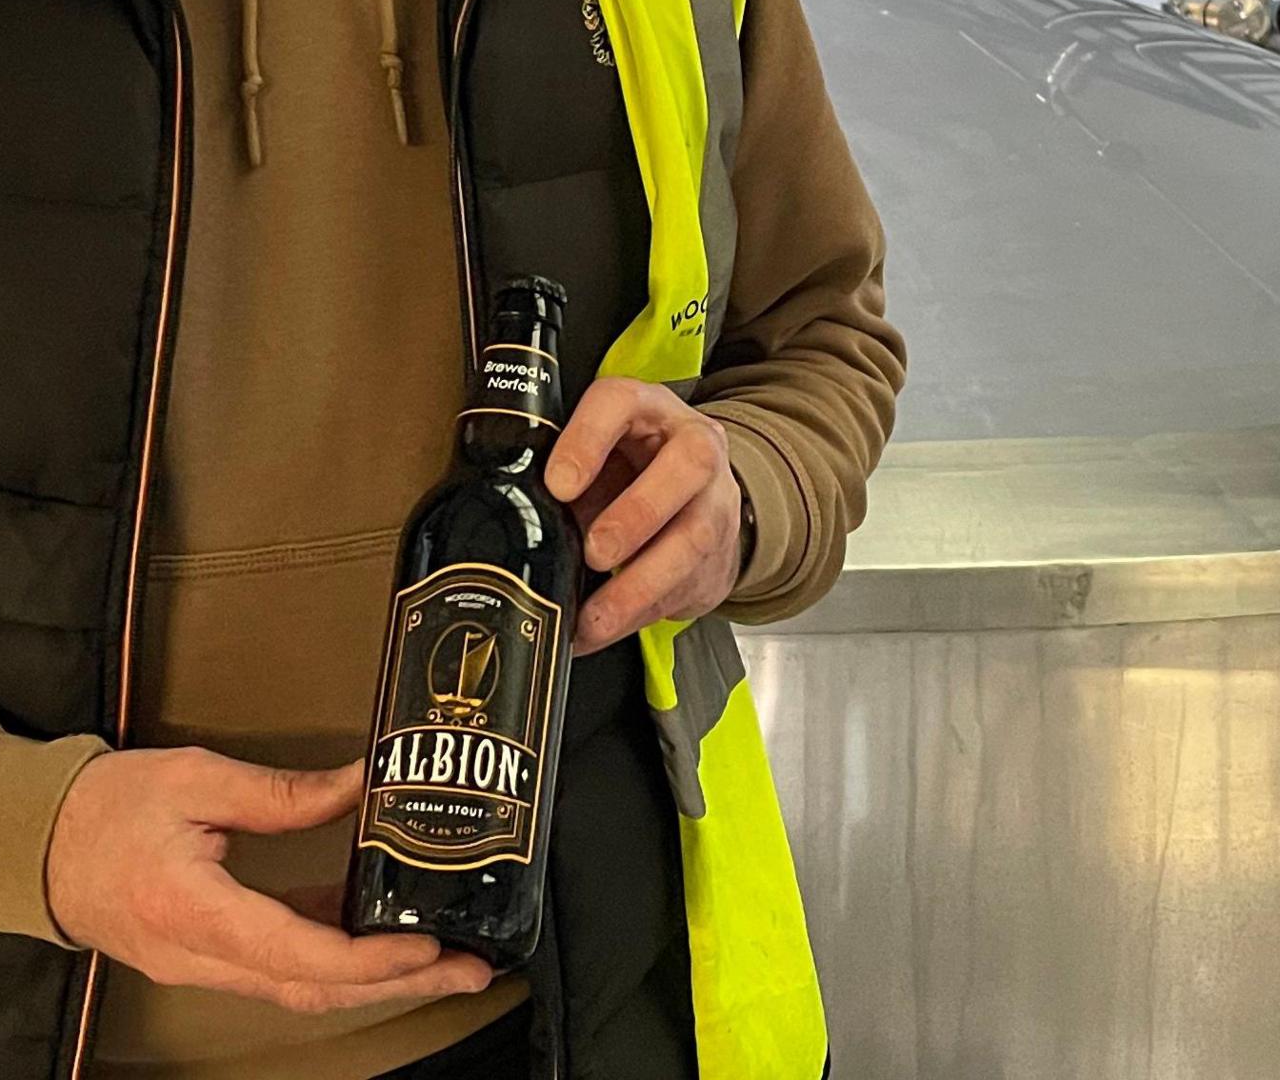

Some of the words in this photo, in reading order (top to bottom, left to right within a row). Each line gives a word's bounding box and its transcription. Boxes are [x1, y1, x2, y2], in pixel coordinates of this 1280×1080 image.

[484, 360, 538, 378] Brewed
[540, 367, 551, 384] in
[487, 376, 539, 396] Norfolk
[383, 732, 522, 797] ALBION
[405, 801, 444, 813] CREAM
[447, 804, 484, 819] STOUT
